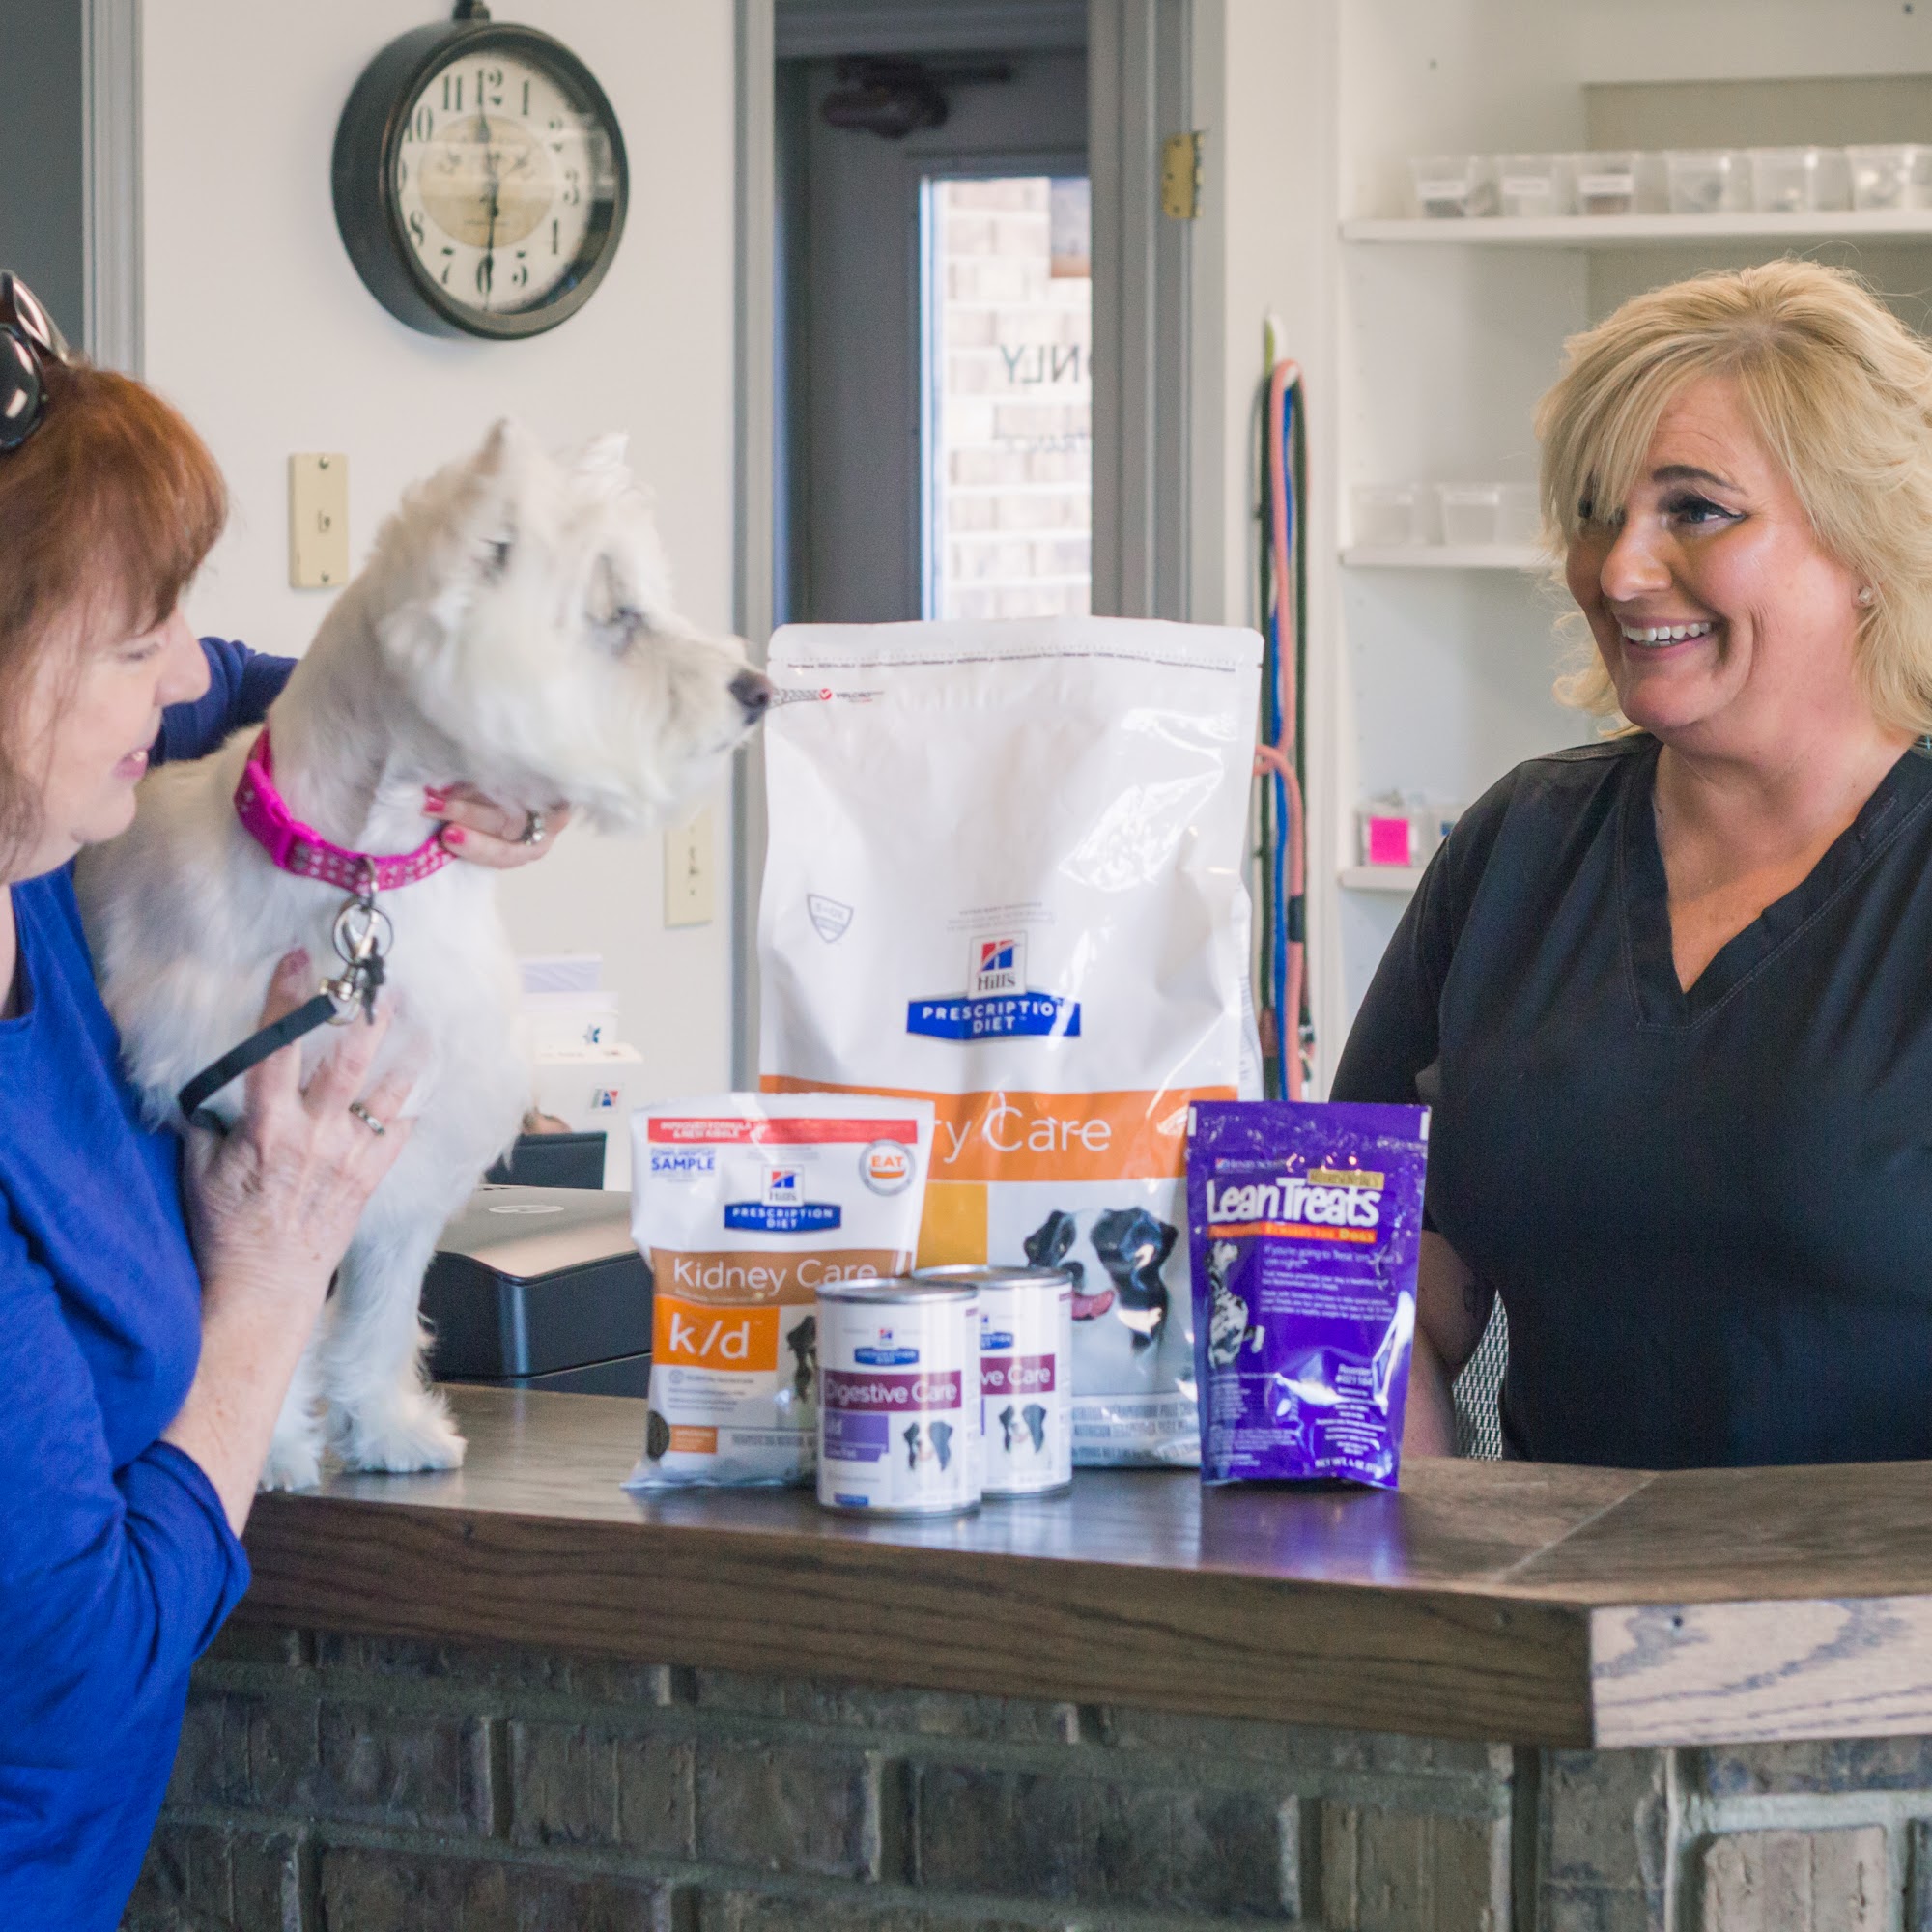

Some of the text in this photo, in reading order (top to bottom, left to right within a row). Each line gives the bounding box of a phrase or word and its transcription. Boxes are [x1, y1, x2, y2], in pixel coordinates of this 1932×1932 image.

[441, 73, 464, 112] 11
[477, 68, 503, 107] 12
[521, 78, 530, 116] 1
[563, 169, 581, 207] 3
[409, 209, 425, 247] 8
[440, 246, 456, 285] 7
[512, 250, 528, 288] 5
[977, 973, 1016, 991] Hill's
[922, 1001, 1063, 1020] PRESCRIPTIO
[973, 1017, 1016, 1034] DIET
[983, 1106, 1111, 1151] Care
[651, 1157, 715, 1171] SAMPLE
[870, 1155, 905, 1169] EAT
[732, 1208, 834, 1220] PRESCRIPTION
[1207, 1177, 1382, 1228] LeanTreats
[766, 1218, 798, 1229] DIET
[673, 1258, 877, 1296] Kidney Care
[669, 1312, 751, 1359] k/d
[824, 1378, 958, 1406] Digestive Care
[1007, 1363, 1052, 1385] Care
